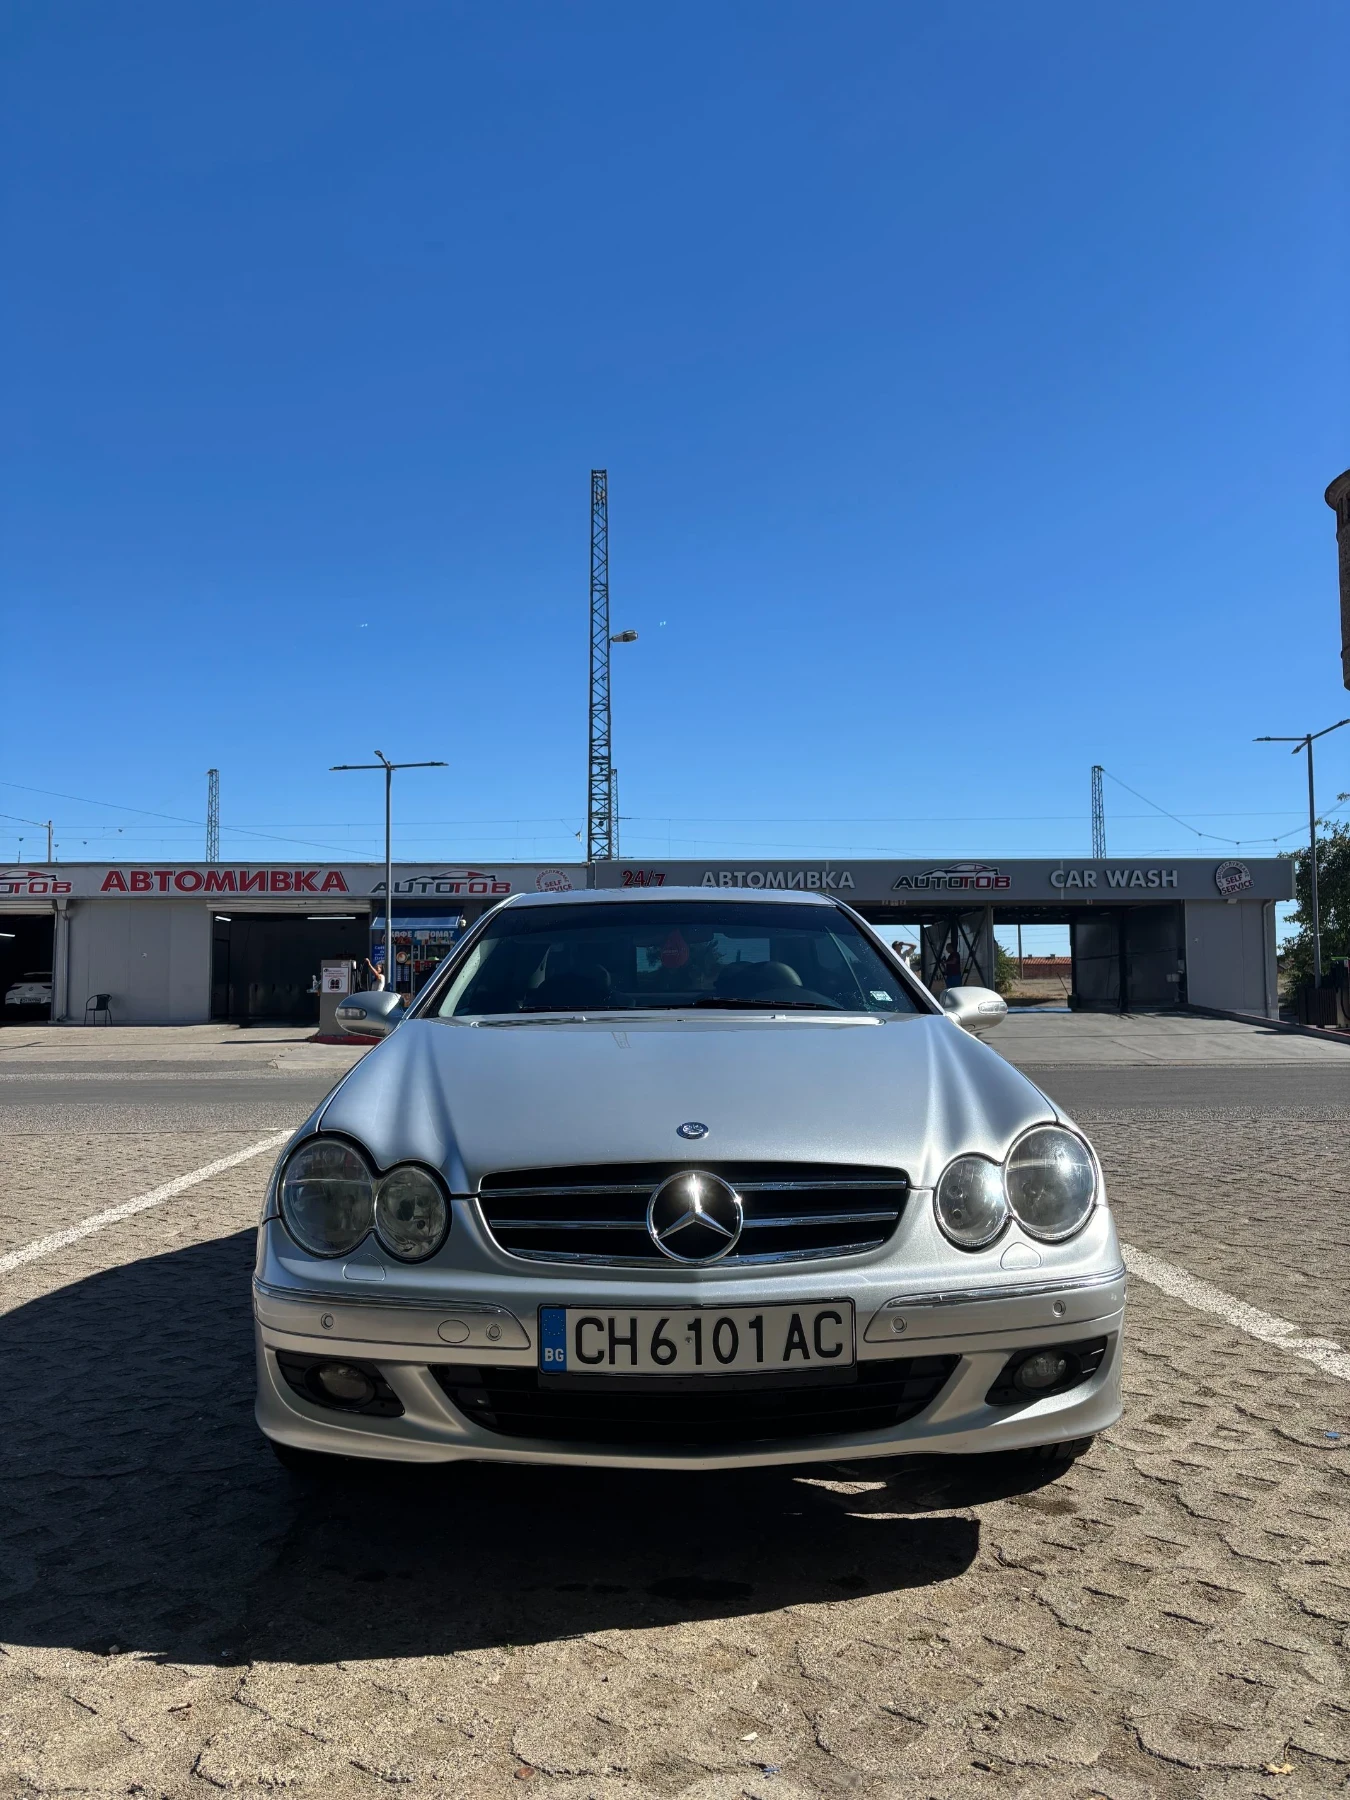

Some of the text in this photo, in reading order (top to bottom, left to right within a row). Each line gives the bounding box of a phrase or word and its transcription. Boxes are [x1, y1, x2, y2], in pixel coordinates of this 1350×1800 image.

[100, 870, 349, 893] АВТОМИВКА
[544, 879, 562, 888] SELF
[622, 870, 667, 887] 24/7
[701, 871, 856, 889] АВТОМИВКА
[892, 876, 1011, 889] AUTOTOB
[1050, 870, 1178, 888] CAR WASH
[1225, 874, 1243, 885] SELF
[370, 882, 511, 894] AUTOTOB
[1221, 880, 1254, 895] SERVICE
[544, 1347, 565, 1362] BG
